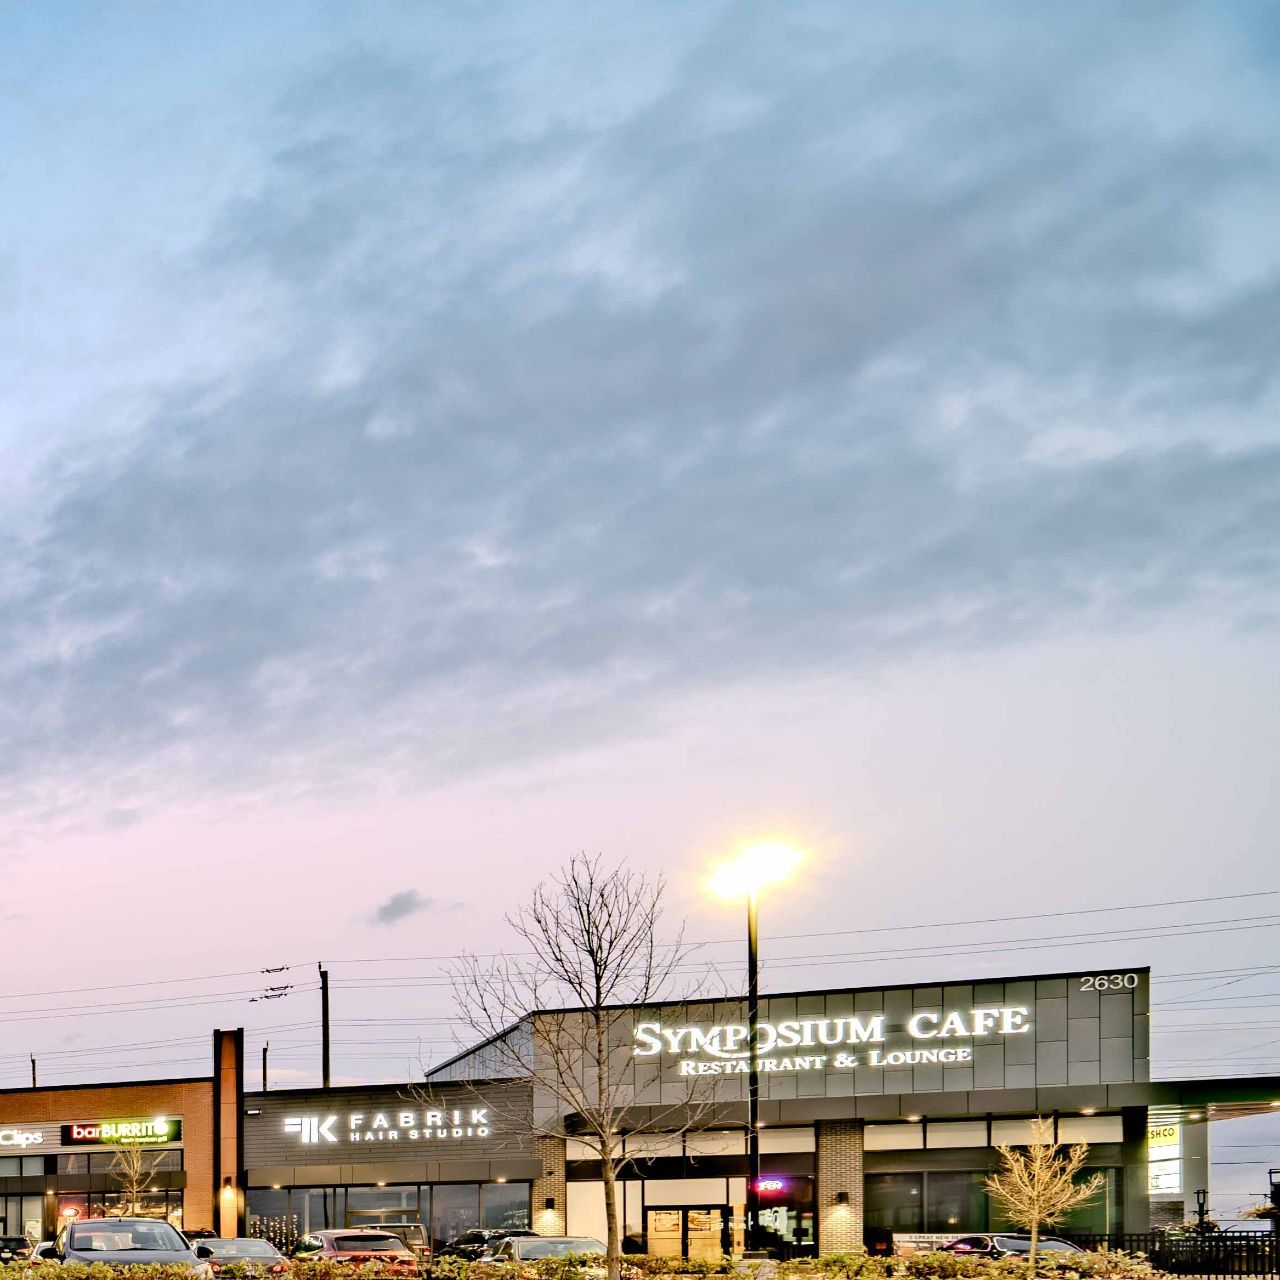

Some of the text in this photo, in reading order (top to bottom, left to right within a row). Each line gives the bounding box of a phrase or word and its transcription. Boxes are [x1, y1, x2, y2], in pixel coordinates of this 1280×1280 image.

[1079, 973, 1139, 992] 2630
[634, 1007, 1030, 1059] SYMPOSIUM CAFE
[834, 1053, 858, 1068] &
[869, 1049, 972, 1066] LOUNGE
[350, 1109, 488, 1130] FABRIK
[350, 1127, 489, 1142] HAIR STUDIO
